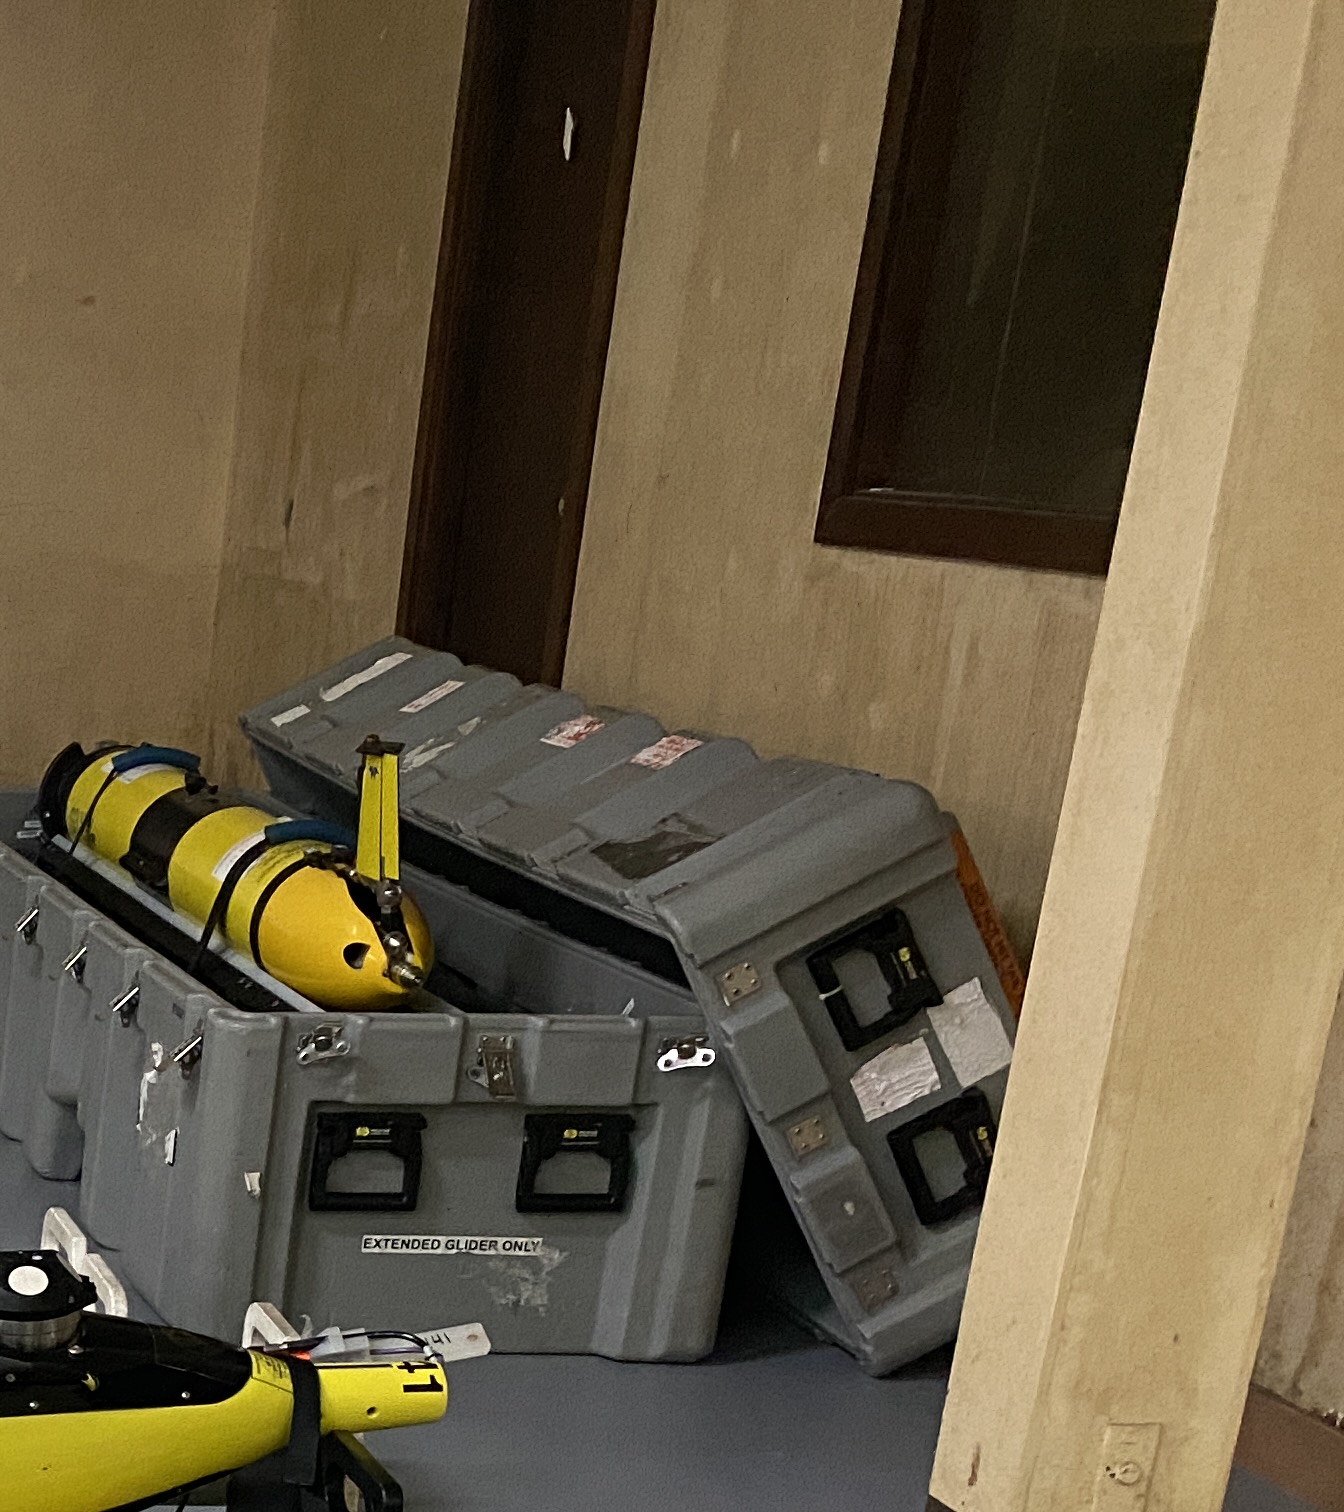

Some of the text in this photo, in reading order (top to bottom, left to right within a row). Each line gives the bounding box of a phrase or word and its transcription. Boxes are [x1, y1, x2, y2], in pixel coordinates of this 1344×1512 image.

[363, 1237, 541, 1253] EXTENDED GLIDER ONLY
